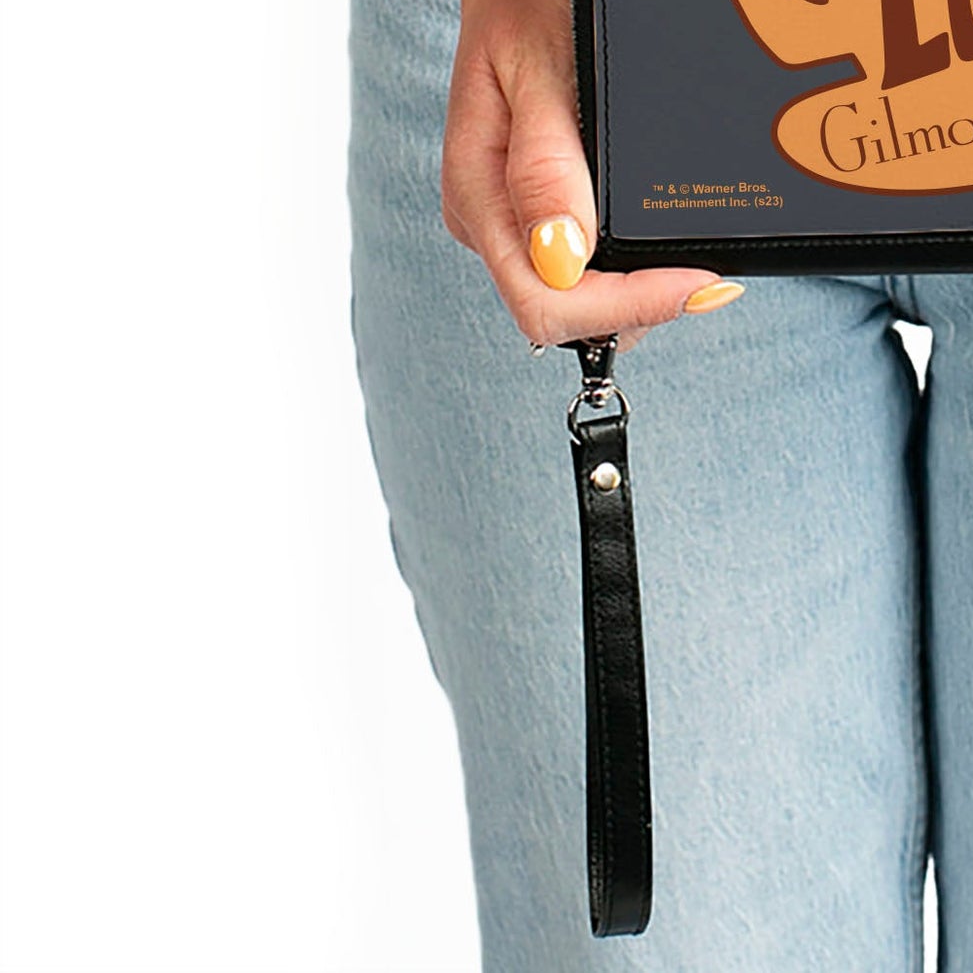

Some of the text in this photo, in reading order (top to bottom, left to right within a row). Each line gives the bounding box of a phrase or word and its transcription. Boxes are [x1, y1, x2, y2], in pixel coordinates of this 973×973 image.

[667, 184, 678, 195] &
[679, 184, 691, 195] ©
[691, 183, 736, 195] Warner
[737, 182, 772, 194] Bros.
[642, 195, 785, 210] Entertainment Inc. (s23)
